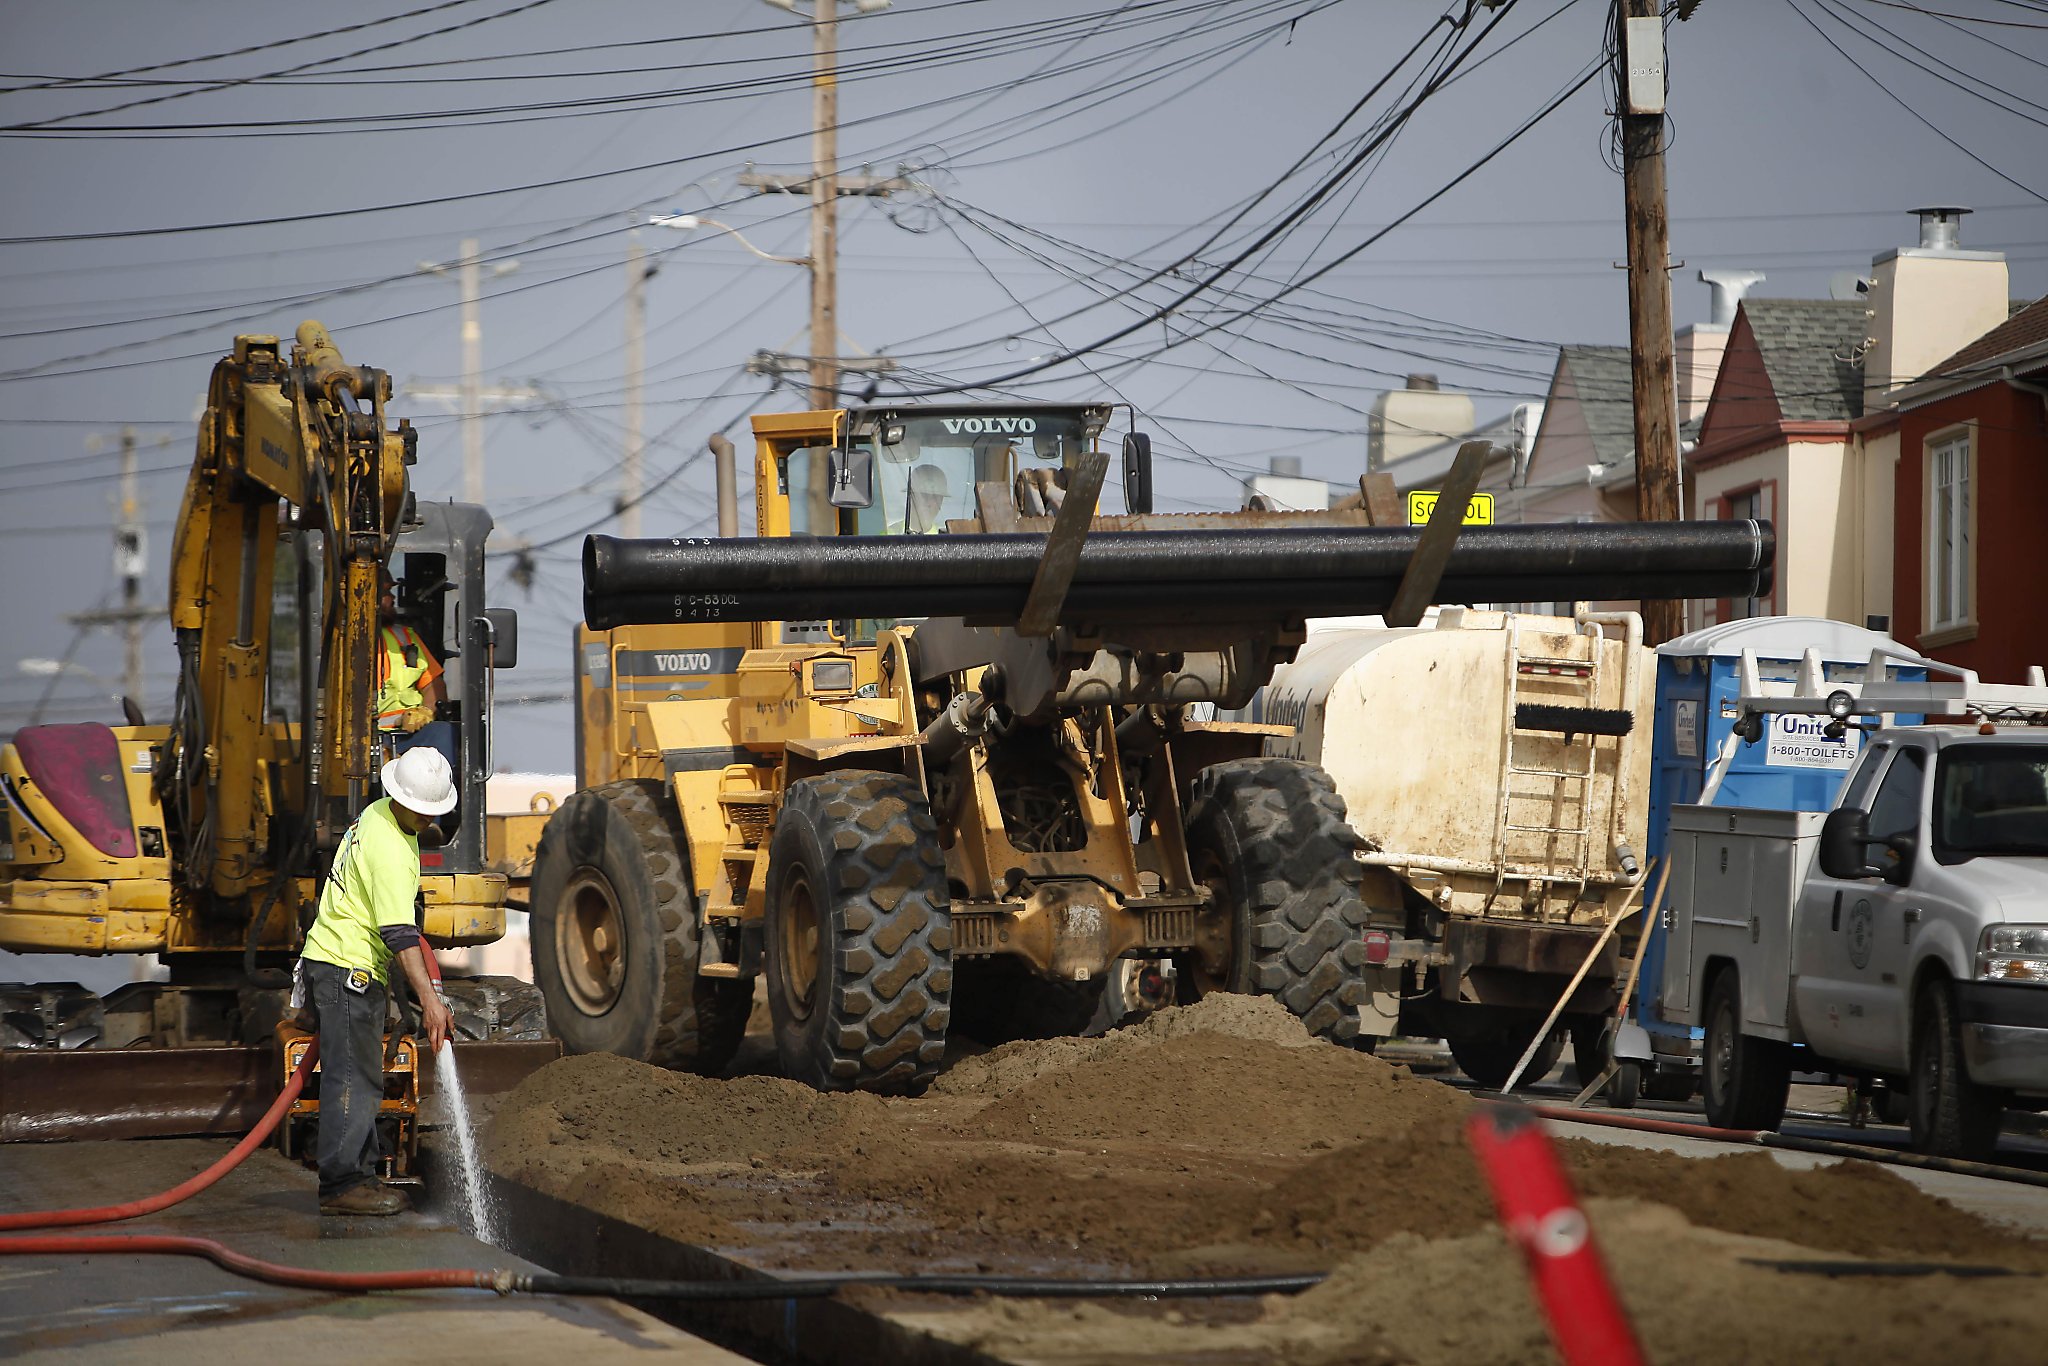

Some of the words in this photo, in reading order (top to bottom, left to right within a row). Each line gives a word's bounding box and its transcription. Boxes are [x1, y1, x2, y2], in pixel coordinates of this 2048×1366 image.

[940, 417, 1037, 435] VOLVO
[1415, 501, 1487, 519] SCOL
[654, 652, 712, 672] VOLVO
[1265, 686, 1313, 734] United
[1783, 717, 1847, 736] Unit
[1771, 745, 1856, 759] 1-800-TOILETS
